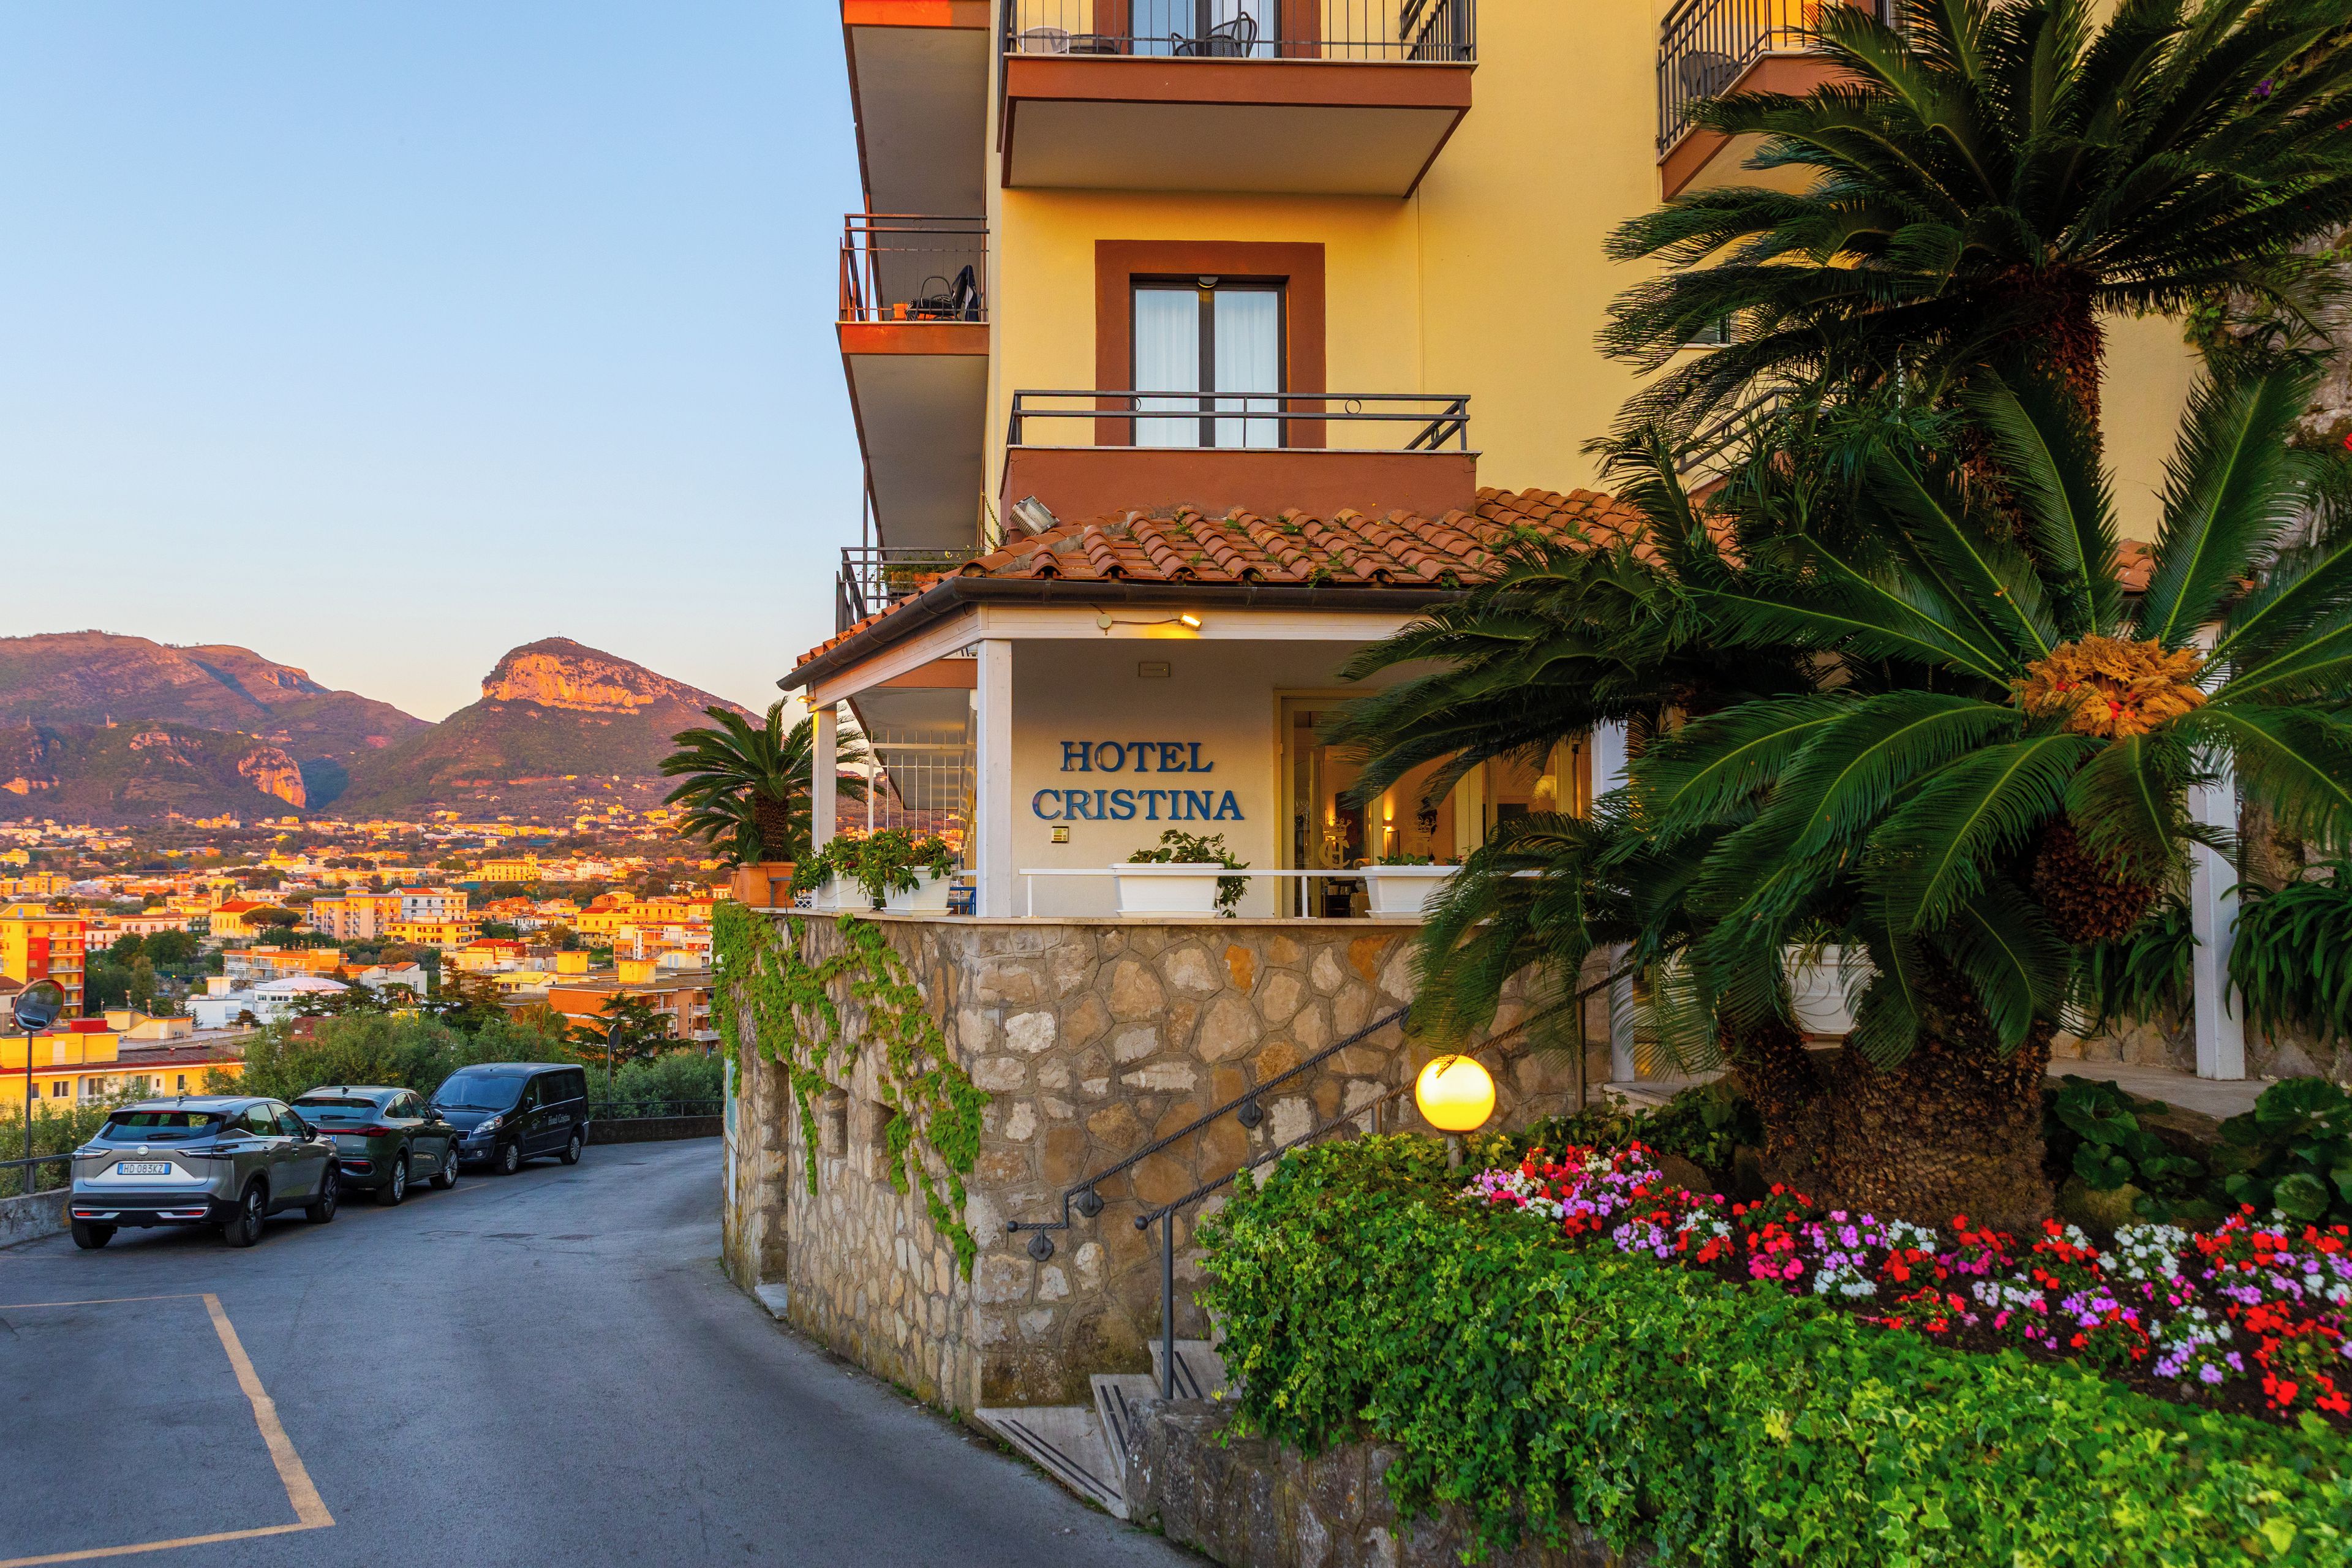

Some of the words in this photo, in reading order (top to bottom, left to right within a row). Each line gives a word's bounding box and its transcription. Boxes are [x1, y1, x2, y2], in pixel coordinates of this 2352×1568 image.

[1060, 741, 1214, 772] HOTEL
[1032, 789, 1245, 820] CRISTINA
[548, 1114, 558, 1125] Hotel
[123, 1164, 135, 1173] HD
[137, 1164, 164, 1173] 083KZ
